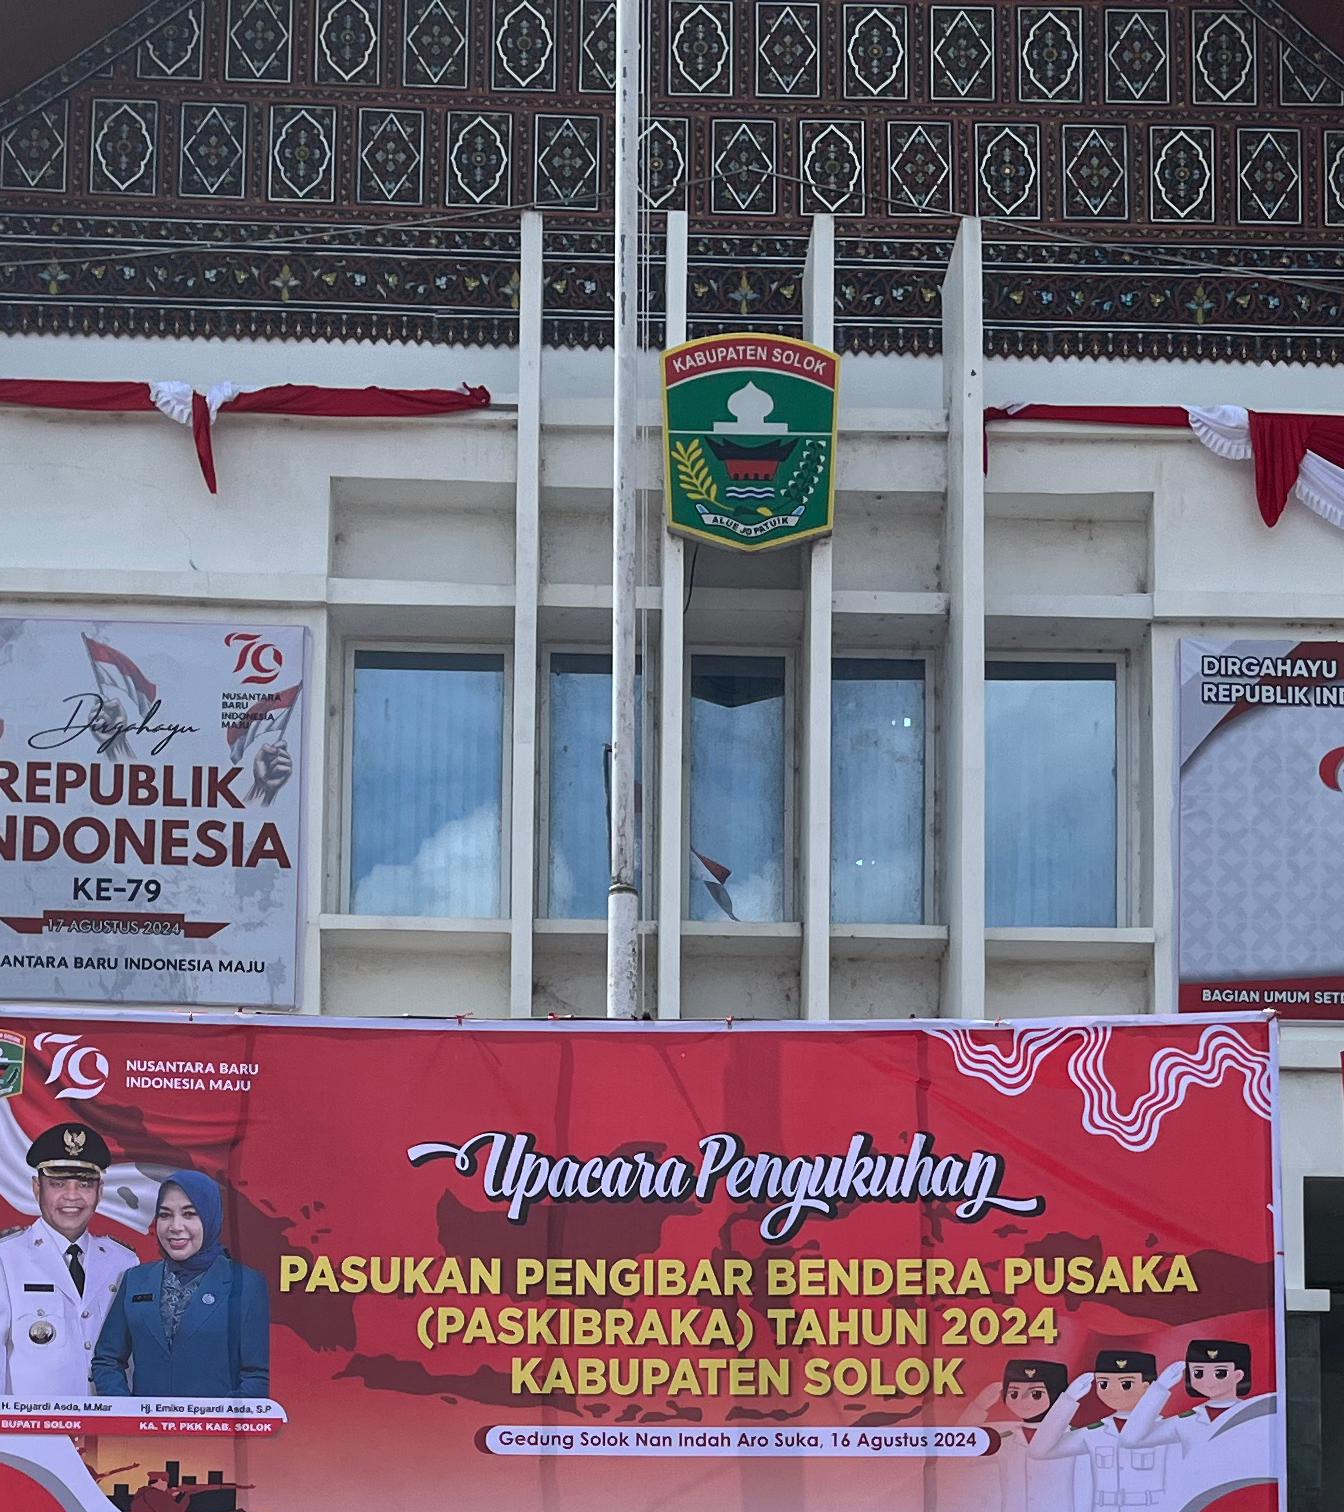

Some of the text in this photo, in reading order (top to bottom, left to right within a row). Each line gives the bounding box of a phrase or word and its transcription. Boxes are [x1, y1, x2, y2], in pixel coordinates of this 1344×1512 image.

[672, 345, 827, 376] KABUPATEN SOLOK
[711, 516, 740, 530] ALUE
[753, 516, 790, 535] PATUIK
[224, 632, 283, 685] 79
[1200, 655, 1338, 680] DIRGAHAYU
[221, 692, 282, 702] NUSANTARA
[1200, 682, 1311, 706] REPUBLIK
[221, 701, 249, 710] BARU
[27, 692, 201, 756] Dirgahayu
[221, 712, 275, 721] INDONESIA
[221, 721, 252, 729] MAJU
[72, 876, 162, 903] KE-79
[47, 918, 182, 936] 17 AGUSTUS 2024
[73, 957, 118, 970] BARU
[124, 957, 214, 972] INDONESIA
[218, 959, 266, 974] MAJU
[1201, 989, 1260, 1003] BAGIAN
[1263, 990, 1310, 1004] UMUM
[32, 1031, 110, 1100] 79
[125, 1059, 259, 1076] NUSANTARA BARU
[125, 1076, 252, 1092] INDONESIA MAJU
[406, 1129, 1045, 1241] Upacara Pengukuhan
[279, 1255, 1199, 1296] PASUKAN PENGIBAR BENDERA PUSAKA
[416, 1306, 1059, 1352] (PASKIBRAKA) TAHUN 2024
[510, 1357, 965, 1396] KABUPATEN SOLOK
[1, 1402, 12, 1411] H.
[13, 1402, 52, 1413] Epyardi
[53, 1402, 81, 1413] Asda,
[83, 1402, 113, 1412] M.Mar
[155, 1404, 185, 1413] Emiko
[187, 1404, 225, 1415] Epyardi
[226, 1405, 254, 1415] Asda,
[256, 1405, 272, 1414] S.P
[1, 1419, 82, 1429] BUPATI SOLOK
[179, 1422, 203, 1431] PKK
[205, 1422, 232, 1432] KAB.
[235, 1423, 273, 1432] SOLOK
[498, 1430, 977, 1451] Gedung Solok Nan Indah Aro Suka, 16 Agustus 2024
